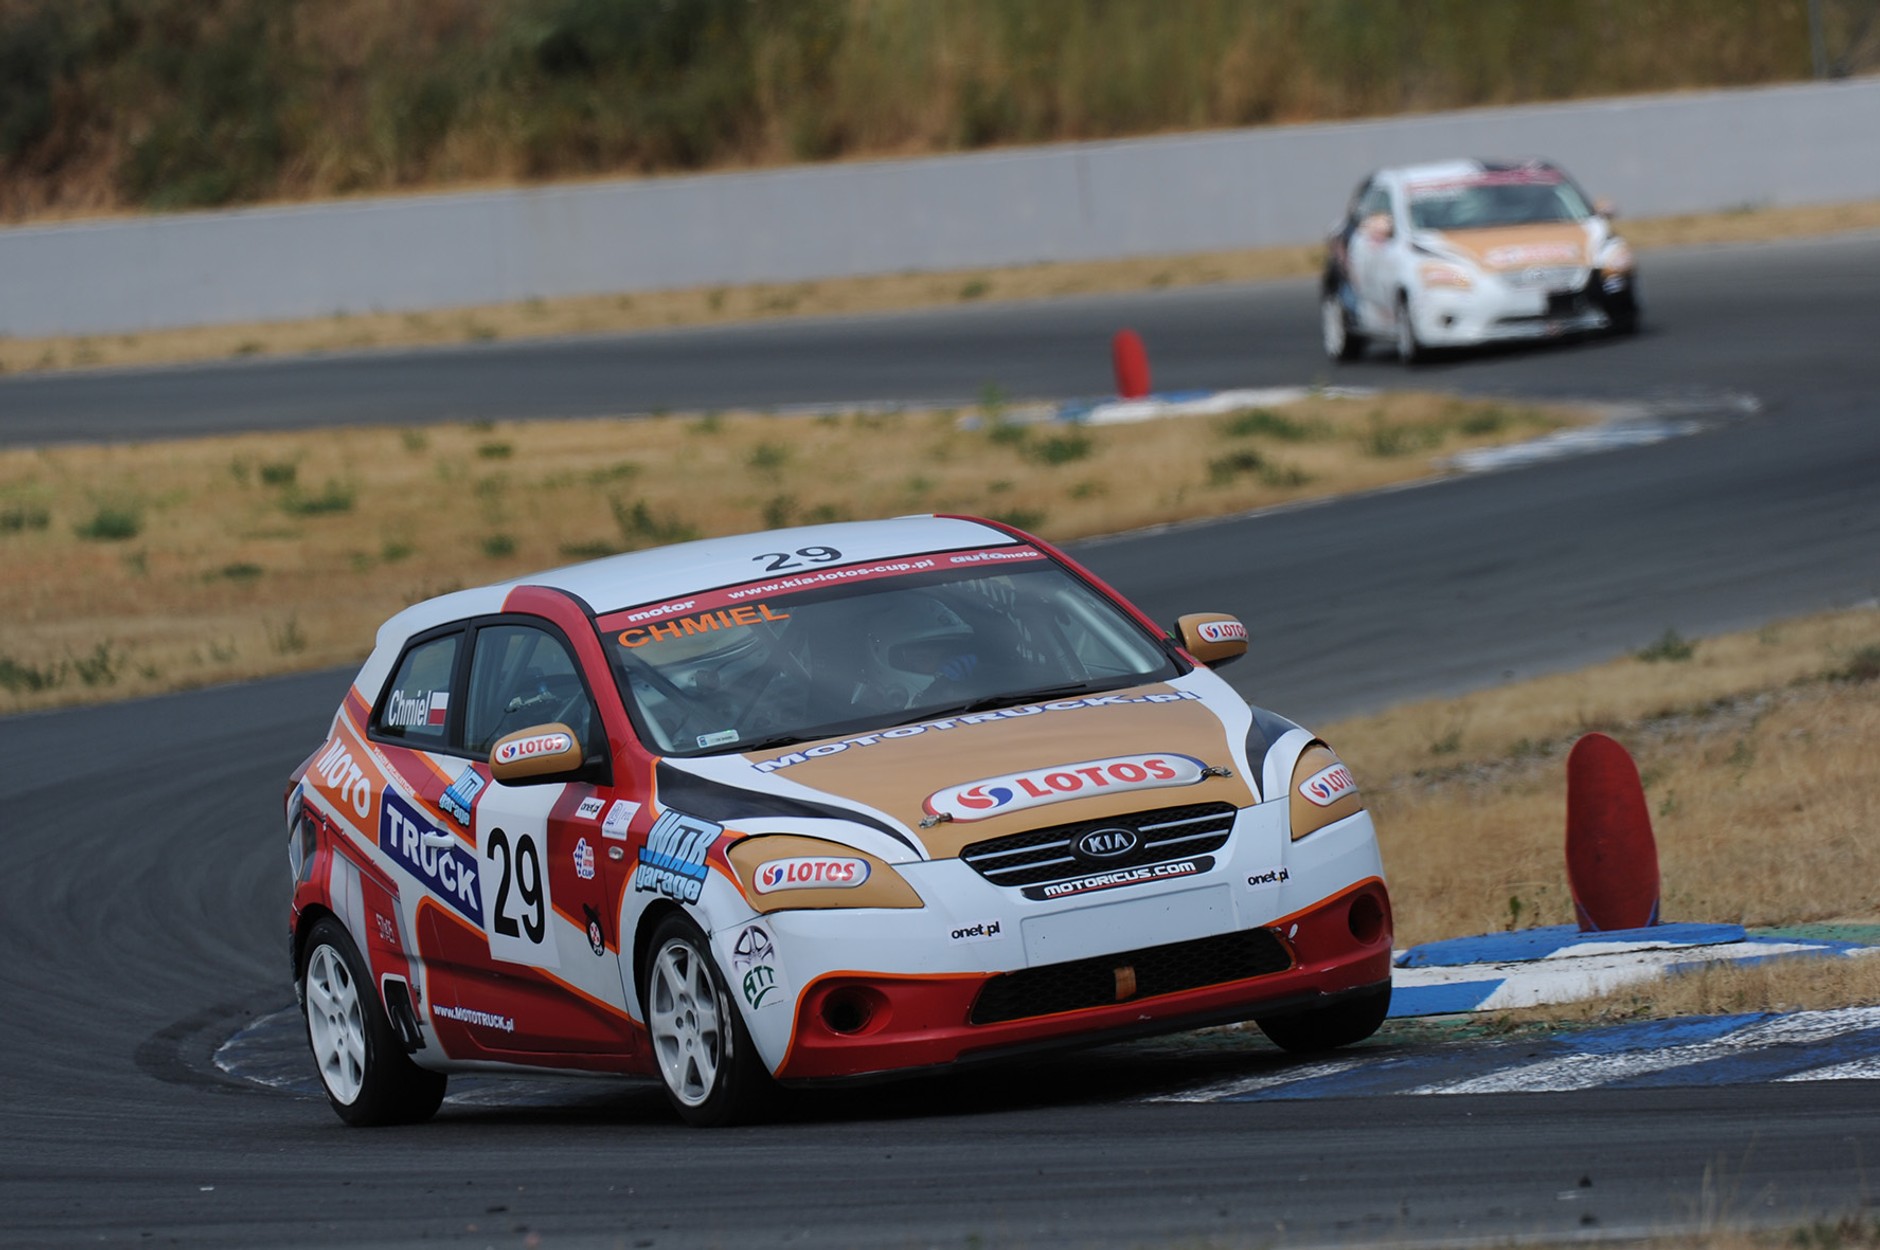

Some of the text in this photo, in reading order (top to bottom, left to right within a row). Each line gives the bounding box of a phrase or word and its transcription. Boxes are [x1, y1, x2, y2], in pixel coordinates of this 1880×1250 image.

[752, 546, 842, 572] 29
[628, 600, 696, 622] motor
[728, 559, 935, 600] www.kia-lotos-cup.pl
[618, 603, 791, 648] CHMIEL
[388, 690, 431, 726] Chmiel
[518, 737, 562, 755] LOTOS
[751, 690, 1203, 773] MOTOTRUCK.pl
[316, 735, 371, 819] MOTO
[1016, 758, 1176, 797] LOTOS
[438, 792, 471, 828] garage
[386, 803, 478, 911] TRUCK
[1088, 833, 1130, 852] KIA
[487, 827, 545, 944] 29
[634, 864, 702, 904] garage
[787, 862, 856, 884] LOTOS
[1247, 868, 1290, 886] onet.pl
[951, 921, 1000, 940] onet.pl
[433, 1004, 514, 1033] www.MOTOTRUCK.pl
